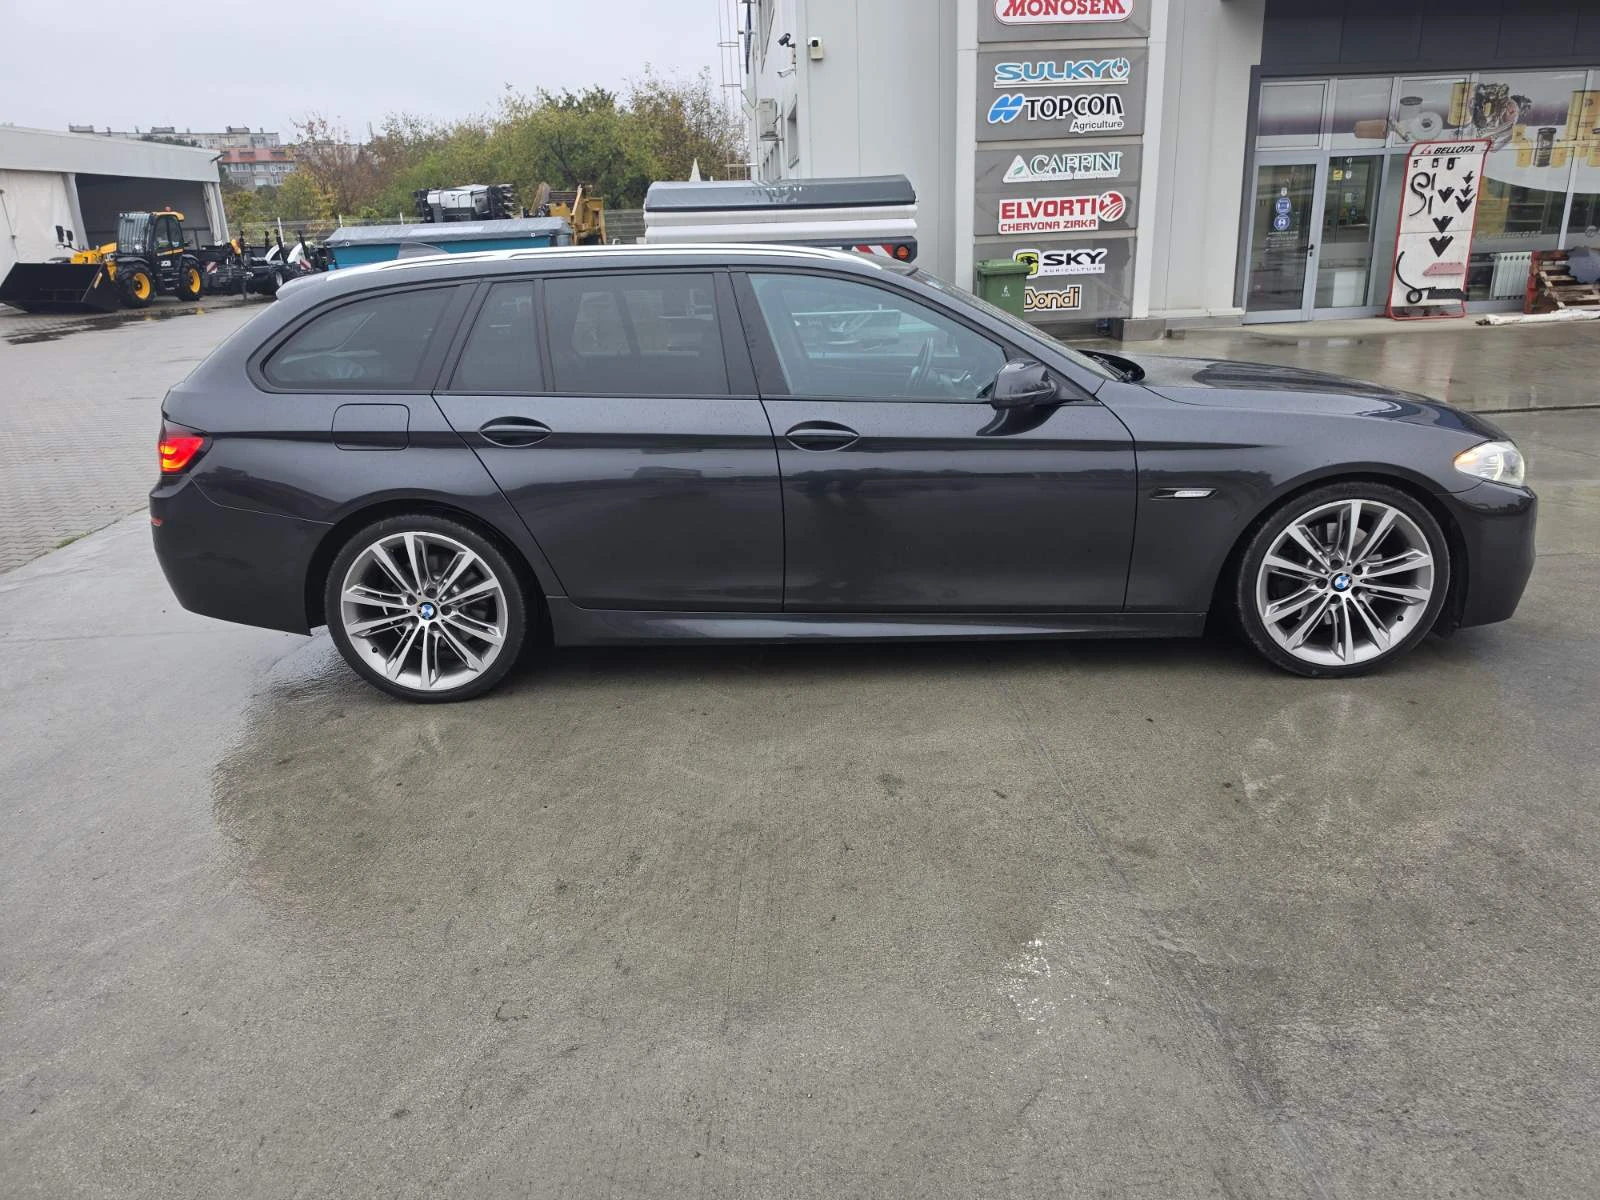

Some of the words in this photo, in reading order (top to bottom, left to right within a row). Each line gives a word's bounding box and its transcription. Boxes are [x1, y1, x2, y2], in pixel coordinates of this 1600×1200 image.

[1002, 0, 1126, 17] MONOSEM
[995, 60, 1110, 81] SULKY
[1025, 95, 1123, 118] TOPCON
[1072, 120, 1123, 131] Agriculture
[1434, 145, 1475, 154] BELLOTA
[1031, 153, 1121, 175] CAFFINI
[1001, 198, 1097, 219] ELVORTI
[1000, 221, 1060, 232] CHERVONA
[1063, 219, 1097, 228] ZIRKA
[1043, 251, 1104, 266] SKY
[1024, 286, 1080, 310] Dondi
